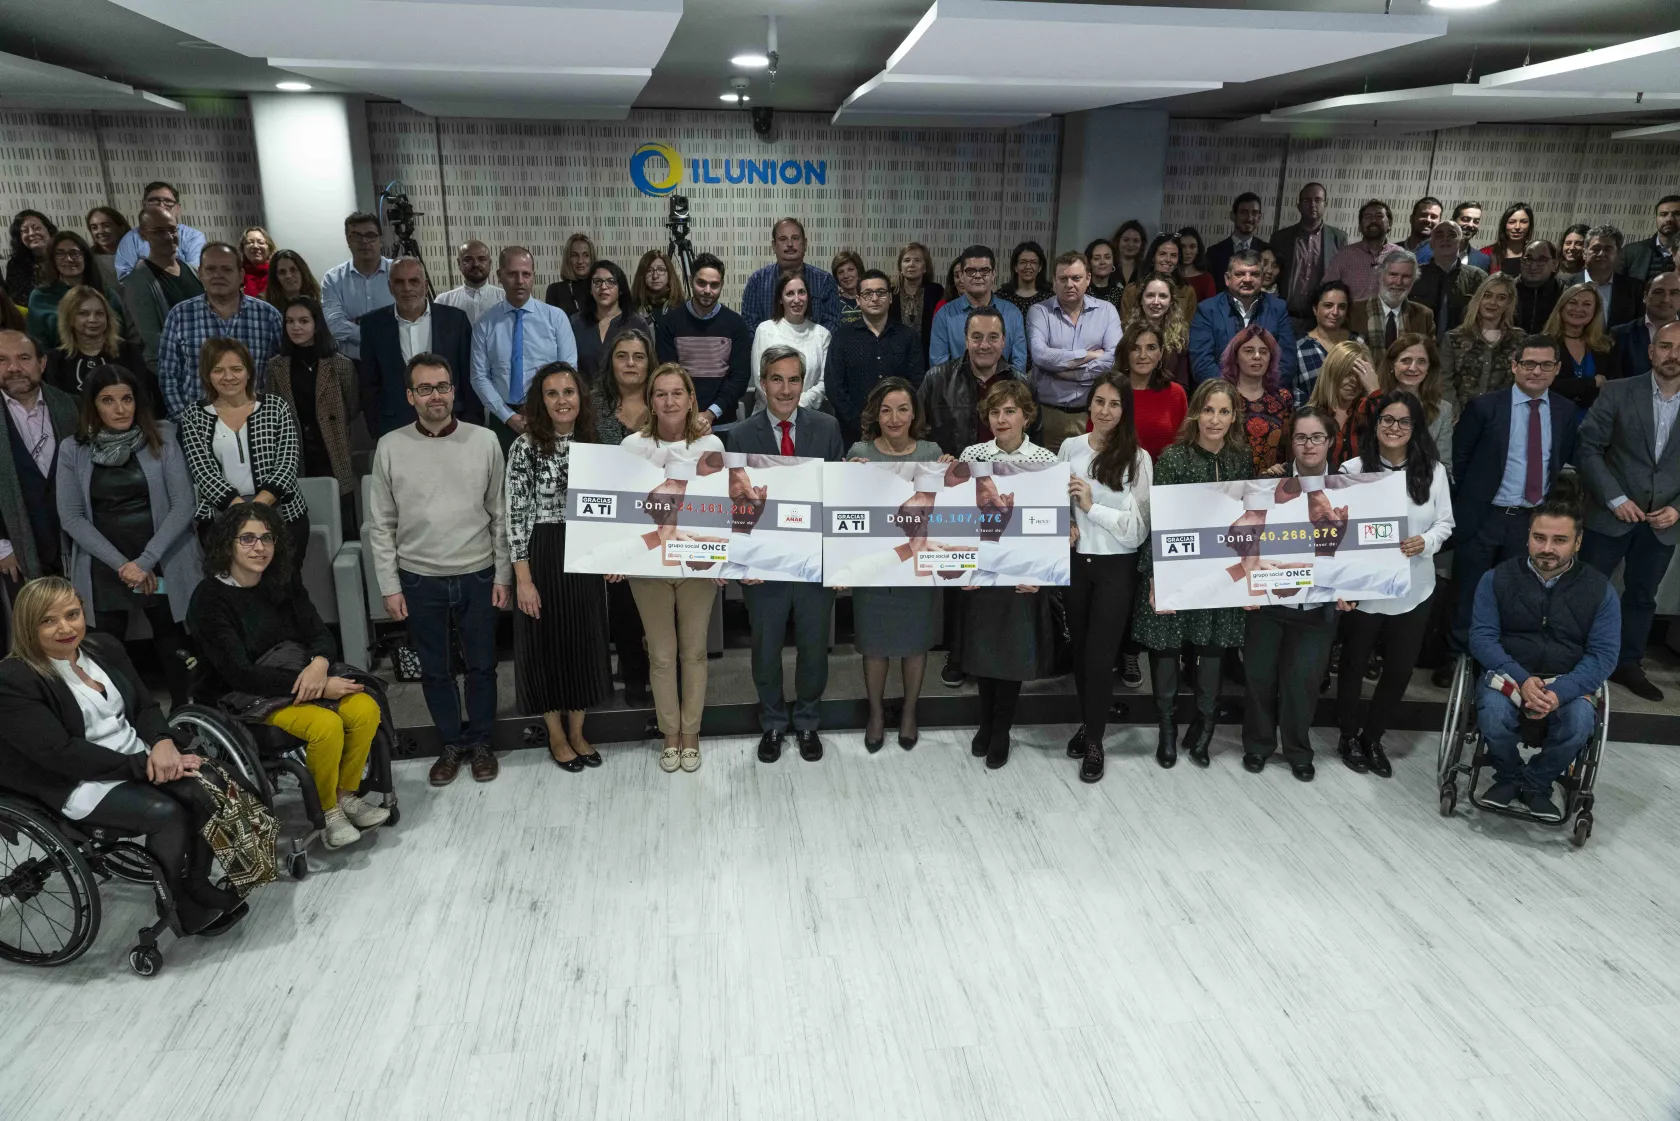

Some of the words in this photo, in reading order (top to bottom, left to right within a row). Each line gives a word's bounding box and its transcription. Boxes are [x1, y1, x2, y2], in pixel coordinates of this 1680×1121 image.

[692, 159, 826, 185] ILUNION
[583, 504, 593, 514] A
[598, 505, 611, 515] TI
[635, 500, 671, 511] Dona
[678, 502, 755, 516] 24.161,20€
[887, 514, 921, 523] Dona
[928, 513, 1002, 525] 16.107,47€
[838, 521, 848, 530] A
[852, 521, 865, 530] TI
[1217, 534, 1253, 543] Dona
[1260, 527, 1338, 541] 40.268,67€
[702, 544, 727, 552] ONCE
[1168, 544, 1178, 553] A
[1182, 543, 1195, 552] TI
[1286, 569, 1311, 577] ONCE
